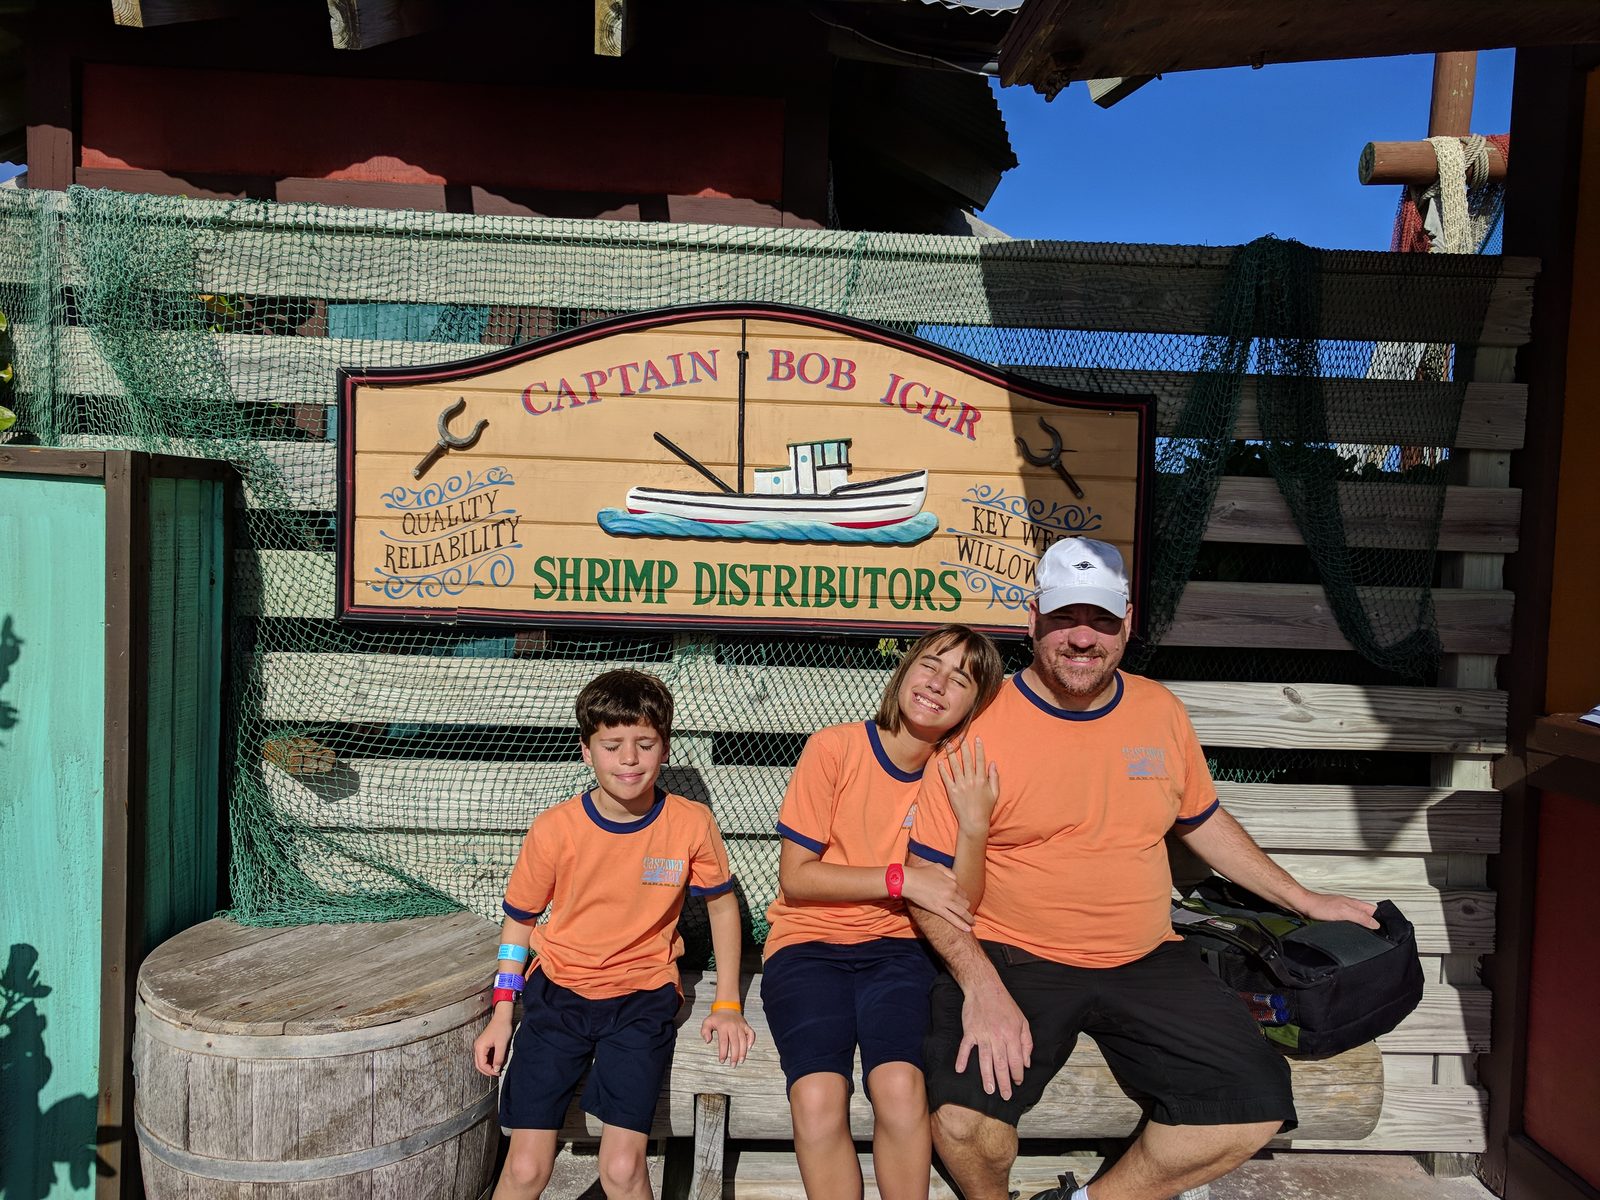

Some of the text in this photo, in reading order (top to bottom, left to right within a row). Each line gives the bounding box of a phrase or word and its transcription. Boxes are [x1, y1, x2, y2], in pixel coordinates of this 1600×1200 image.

[521, 348, 983, 441] CAPTAIN BOB IGER
[402, 489, 500, 536] QUALITY
[972, 506, 1014, 539] KEY
[384, 515, 522, 574] RELIABILITY
[533, 555, 963, 613] SHRIMP DISTRIBUTORS
